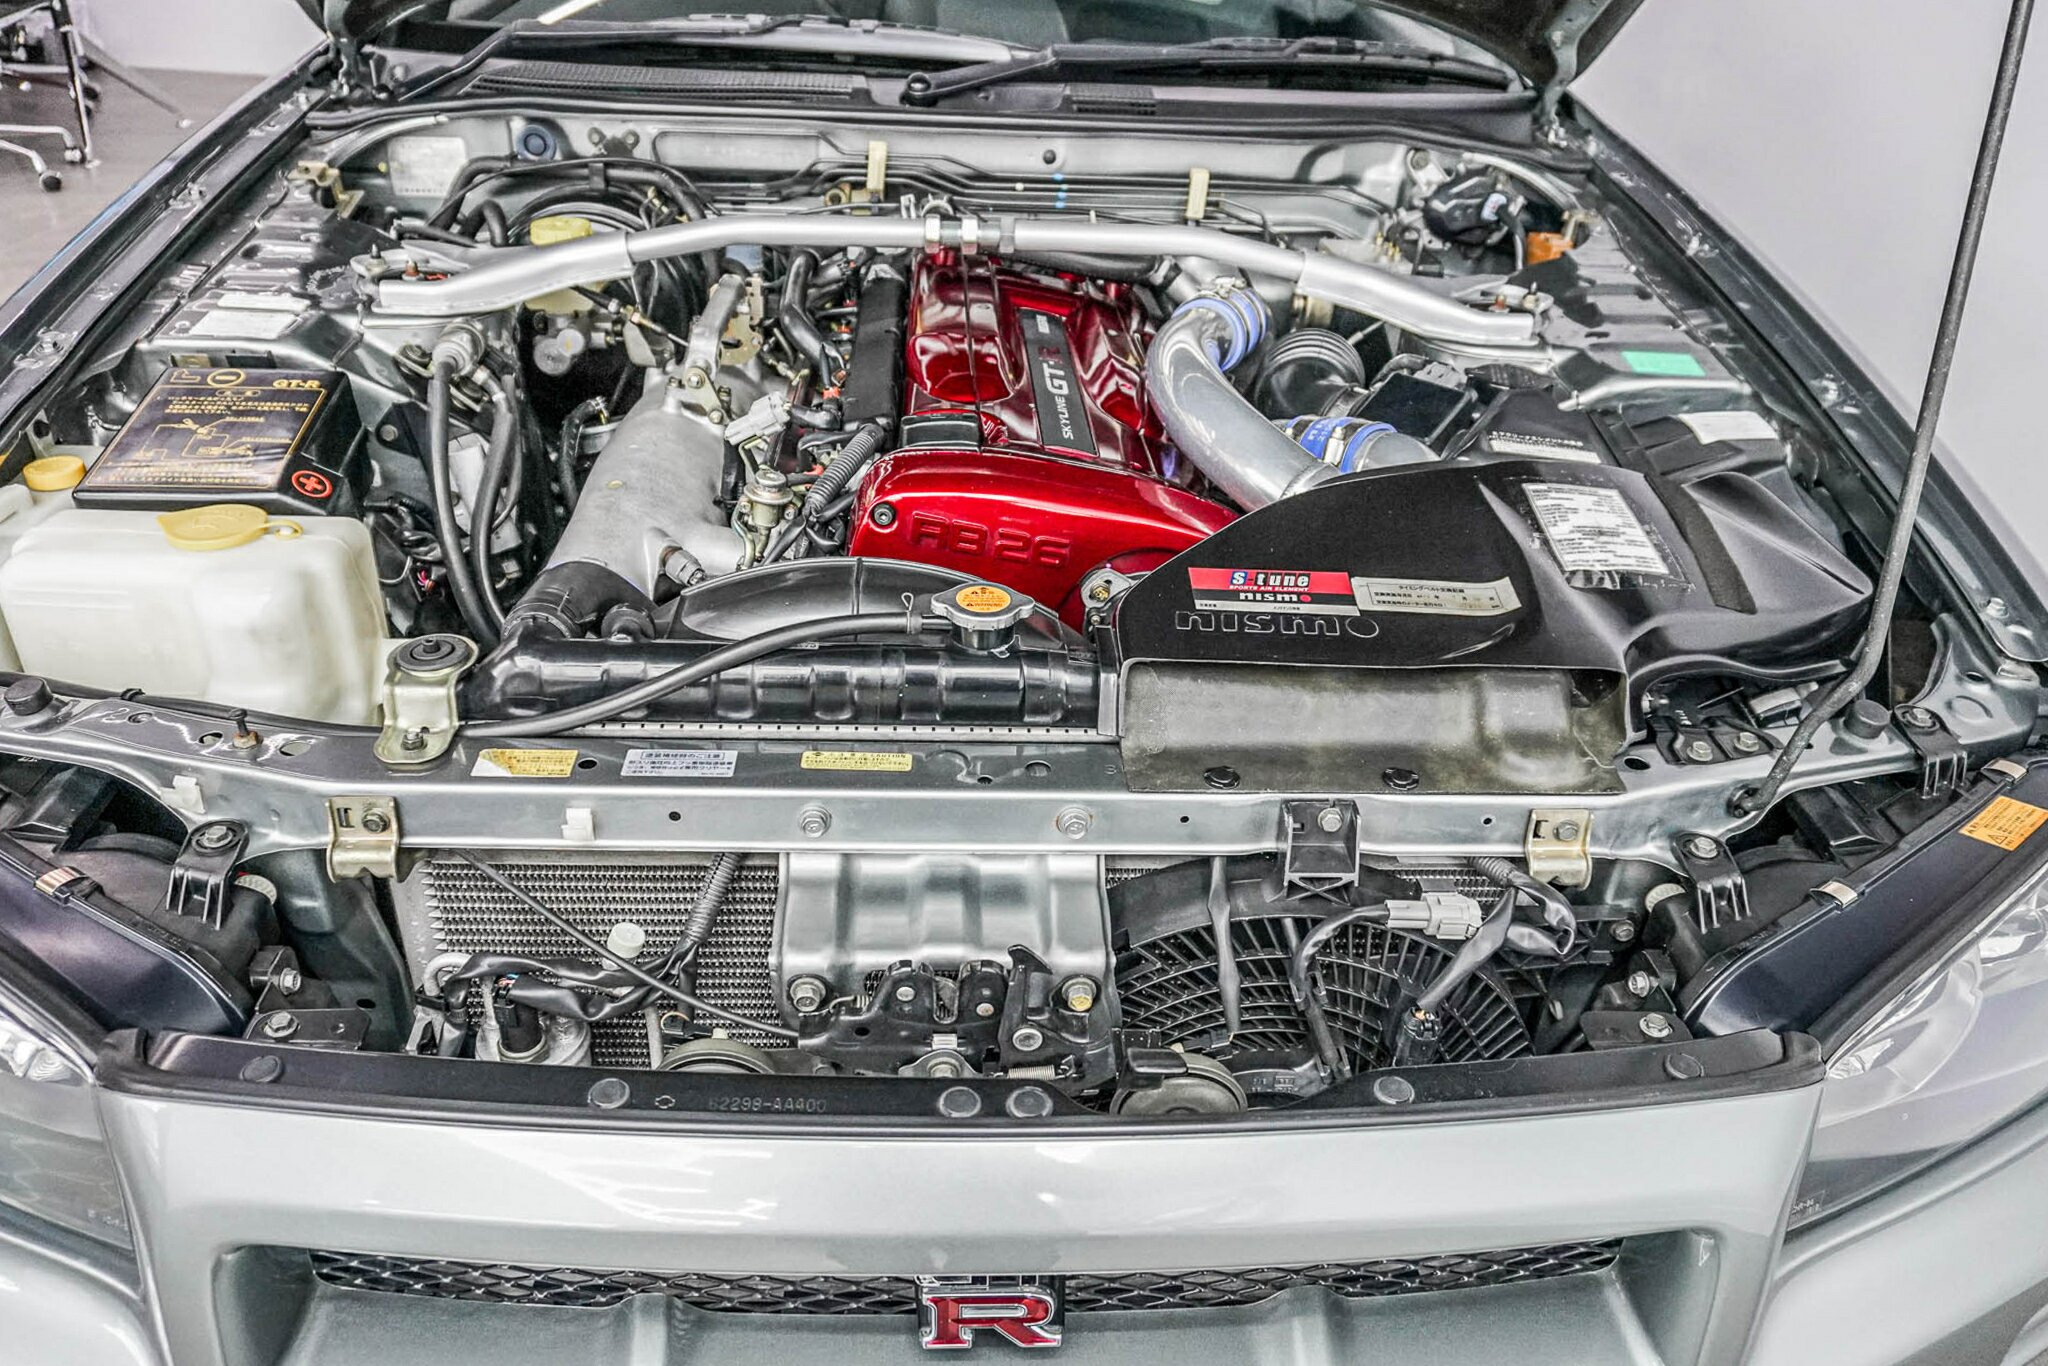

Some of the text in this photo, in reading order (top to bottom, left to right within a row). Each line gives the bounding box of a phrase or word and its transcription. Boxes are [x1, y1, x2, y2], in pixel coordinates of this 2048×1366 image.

[272, 379, 322, 389] GT-R
[1054, 394, 1074, 440] SKYLINE
[1230, 571, 1311, 587] S-tune
[923, 1293, 1062, 1349] R
